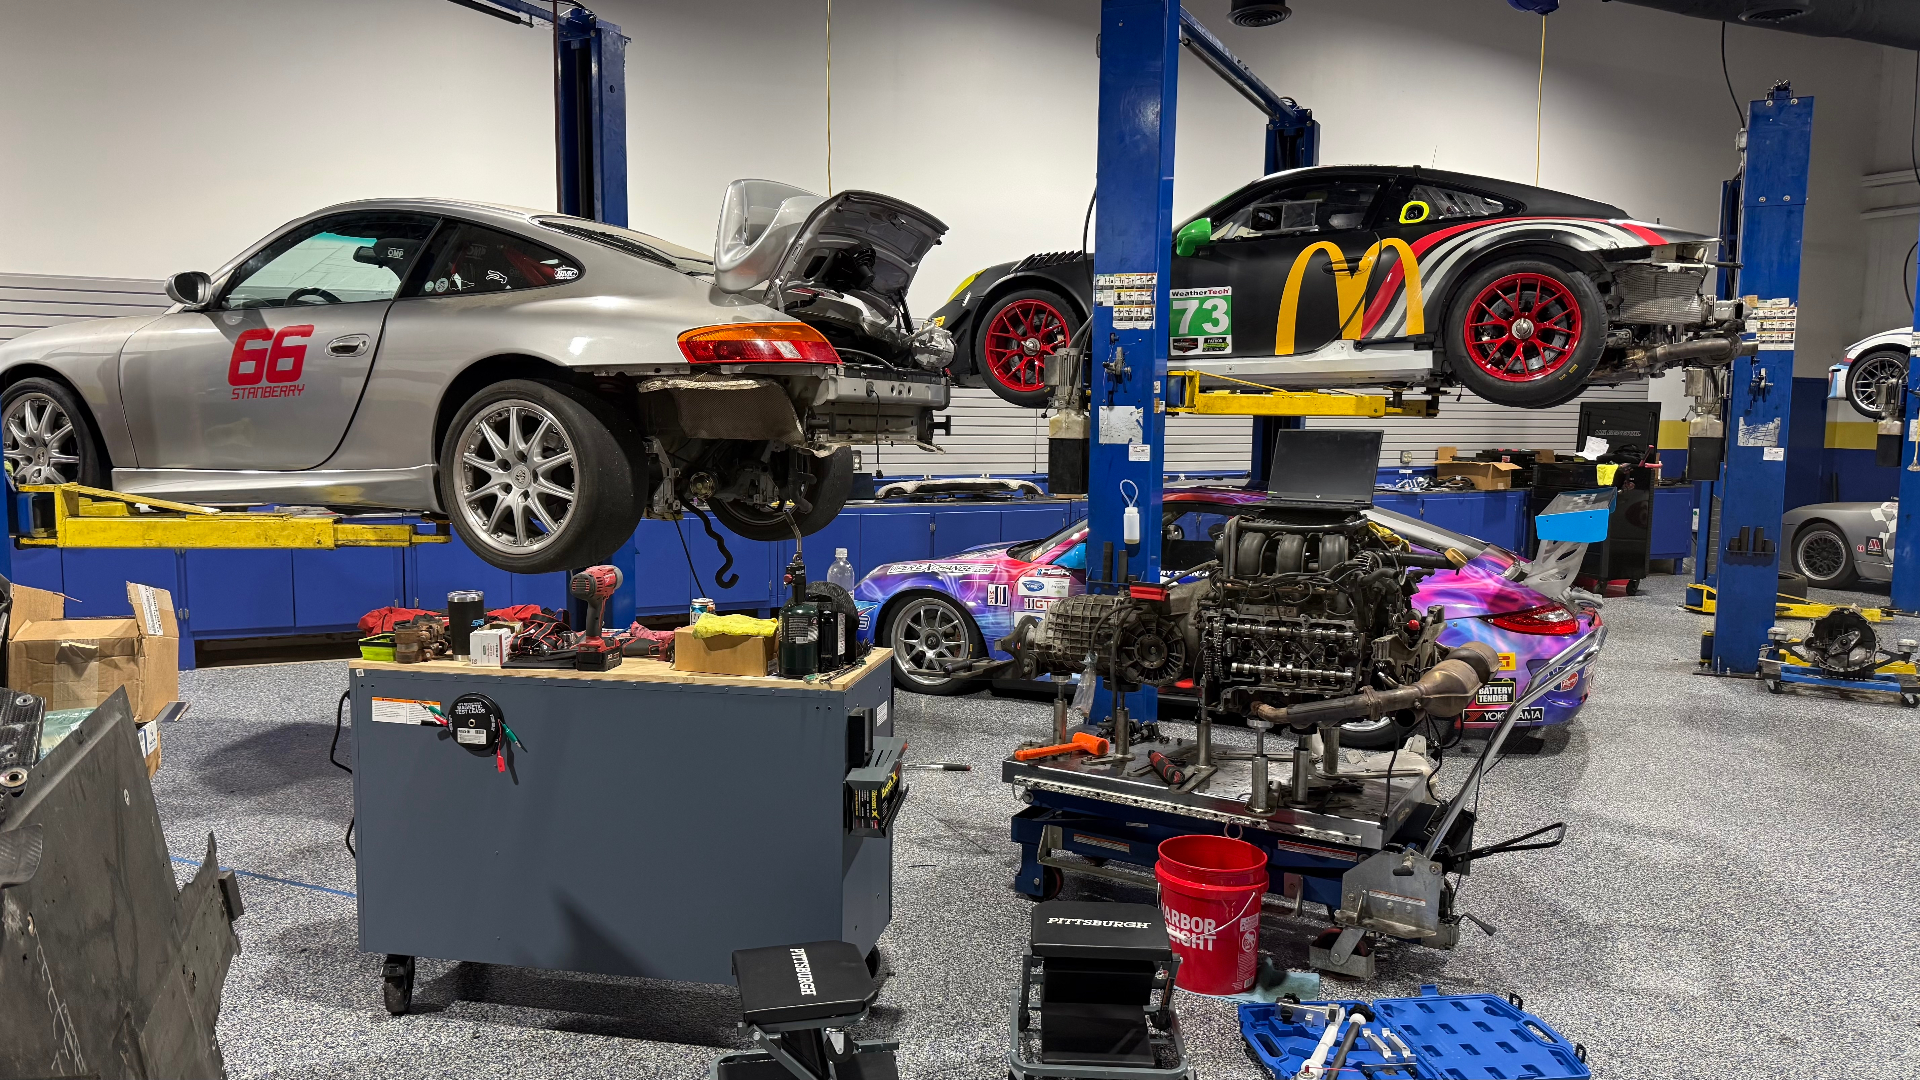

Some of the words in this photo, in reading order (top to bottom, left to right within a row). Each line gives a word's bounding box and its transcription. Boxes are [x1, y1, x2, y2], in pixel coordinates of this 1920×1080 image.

[1171, 289, 1229, 297] WeatherTech
[1172, 298, 1230, 334] 73
[227, 324, 315, 387] 66
[231, 383, 306, 401] STANBERRY
[1478, 686, 1513, 695] BATTERY
[1478, 695, 1508, 703] TENDER
[1484, 711, 1541, 720] YOKAMA
[1046, 917, 1152, 929] PITTSBURGH
[789, 947, 817, 996] PITTSBURGH
